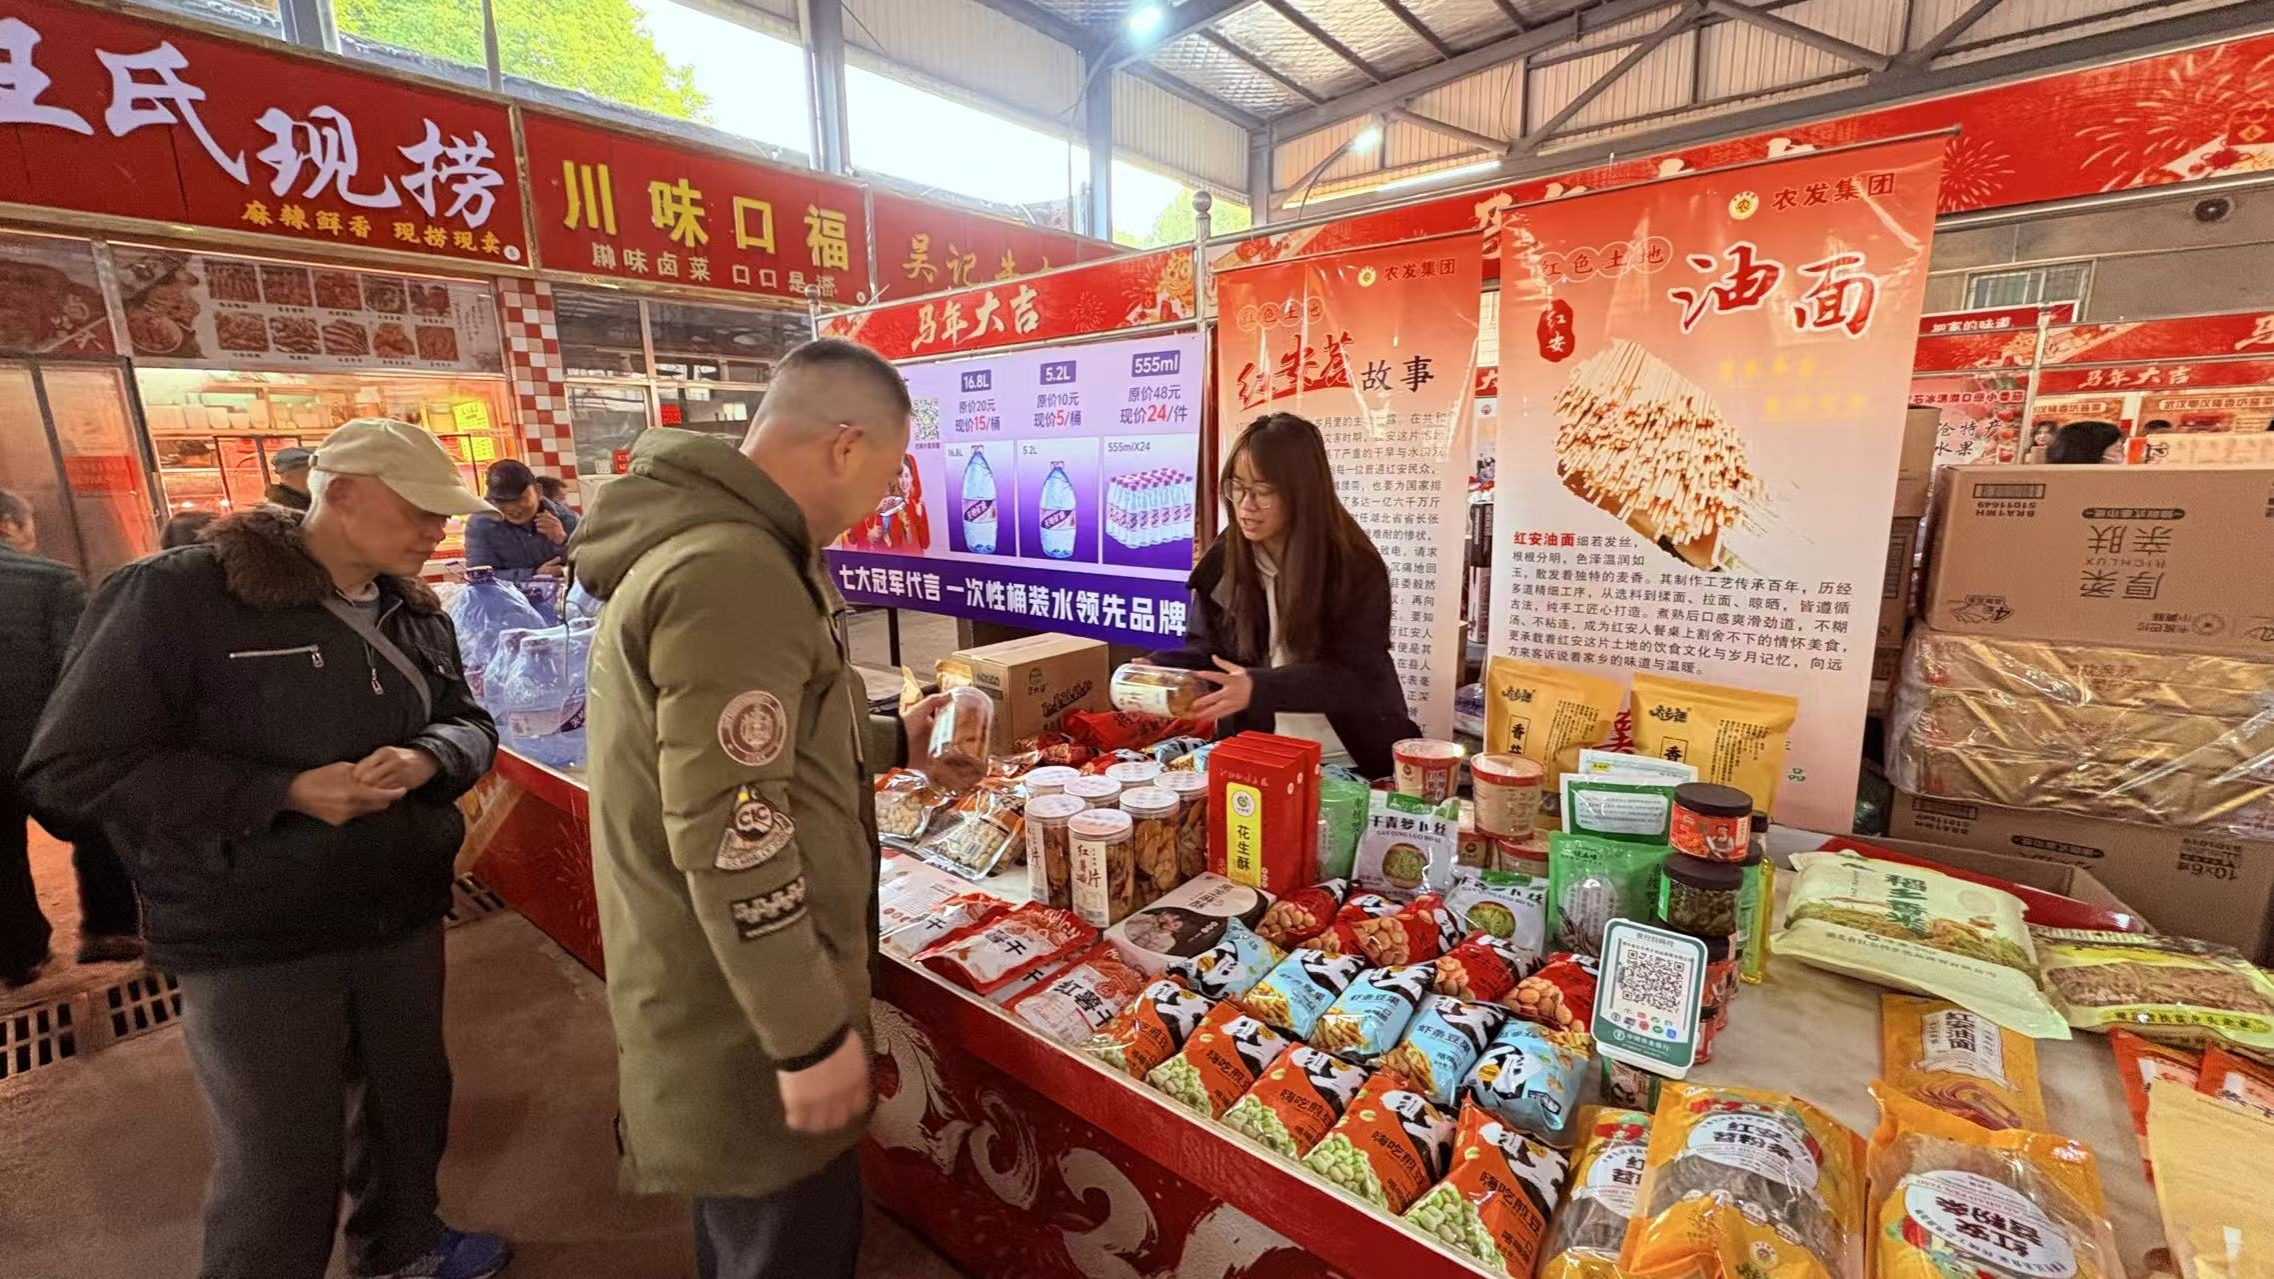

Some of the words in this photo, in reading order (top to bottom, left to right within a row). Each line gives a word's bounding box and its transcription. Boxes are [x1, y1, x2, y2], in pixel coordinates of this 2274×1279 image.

[1771, 172, 1895, 212] 农发集团
[241, 199, 372, 238] 麻辣鲜香
[392, 219, 501, 256] 现捞现卖
[563, 160, 850, 271] 川味口福
[1384, 258, 1456, 282] 农发集团
[1541, 247, 1666, 276] 红色土地
[1668, 242, 1880, 339] 油面
[911, 284, 1041, 353] 马年大吉
[1545, 309, 1567, 353] 红安
[1045, 365, 1071, 382] 5.2L
[1134, 353, 1180, 374] 555ml
[1360, 355, 1435, 393] 故事
[964, 373, 990, 389] 16.8L
[2079, 365, 2192, 389] 马年大吉
[1037, 393, 1080, 408] 原价10元
[1128, 385, 1181, 402] 原价48元
[959, 400, 996, 413] 原价20元
[1033, 410, 1081, 427] 现价5/桶
[1120, 404, 1188, 424] 现价24/件
[955, 416, 1001, 432] 现价15/桶
[1935, 441, 1973, 456] 水果
[1514, 532, 1575, 547] 红安油面
[1577, 536, 1639, 549] 细若发丝，
[2088, 524, 2172, 556] 亲肤
[1512, 551, 1646, 567] 根根分明，色泽温润如
[2080, 570, 2166, 600] 厚柔
[839, 565, 941, 601] 七大冠军代言
[946, 577, 1187, 637] 一次性桶装水领先品牌
[1368, 815, 1447, 836] 干青萝卜丝
[1237, 824, 1251, 871] 花生酥
[1054, 979, 1114, 1027] 红薯干
[1729, 1121, 1782, 1143] 红安
